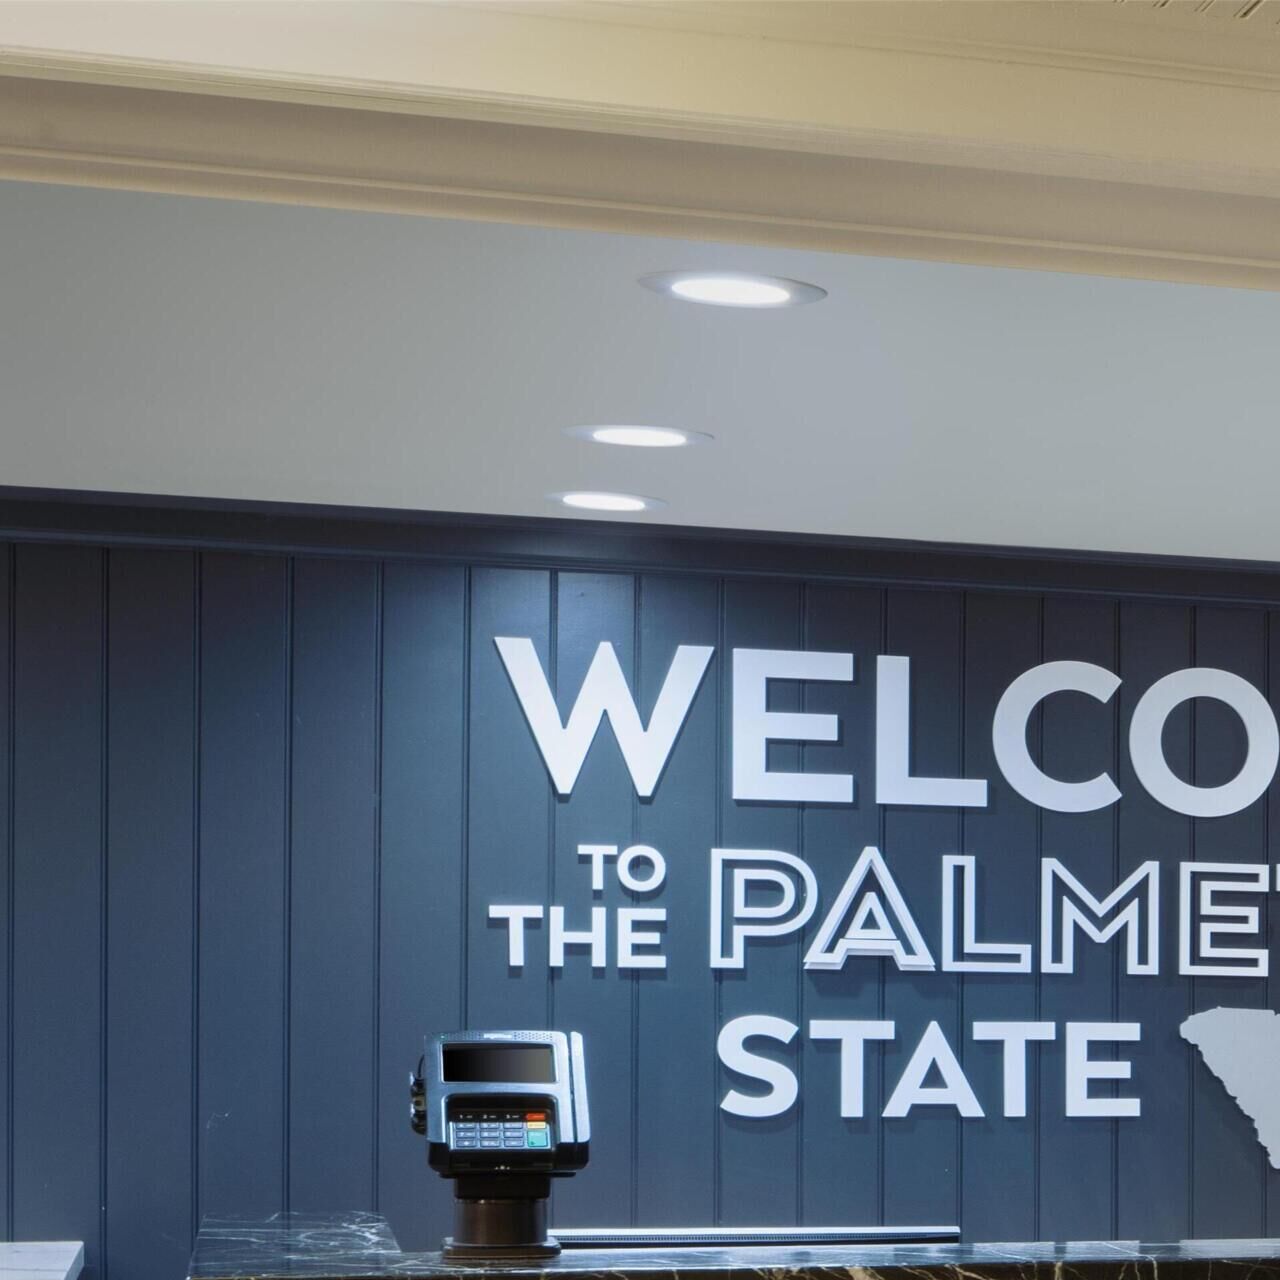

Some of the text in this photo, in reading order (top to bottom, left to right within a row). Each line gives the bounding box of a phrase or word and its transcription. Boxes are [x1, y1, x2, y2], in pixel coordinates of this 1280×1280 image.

[577, 843, 666, 892] TO
[488, 904, 667, 969] THE
[717, 1014, 1141, 1118] STATE
